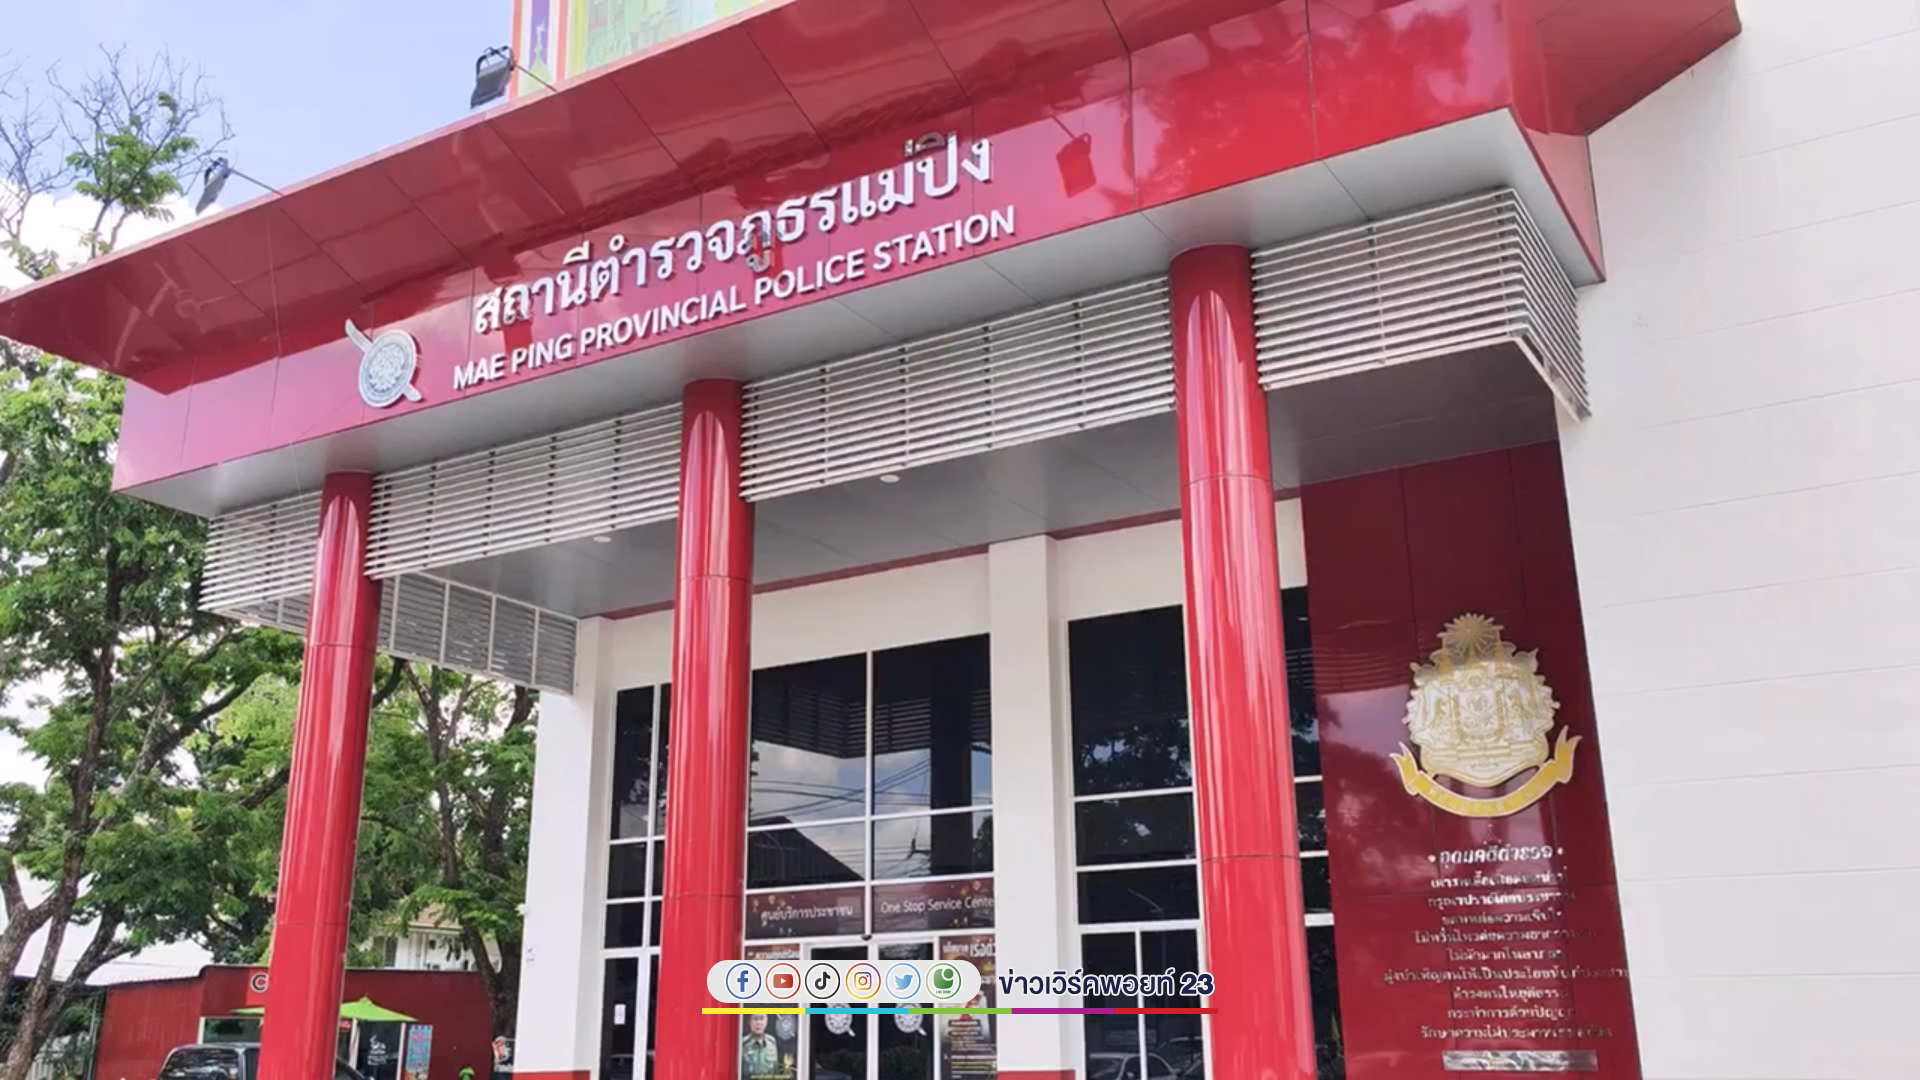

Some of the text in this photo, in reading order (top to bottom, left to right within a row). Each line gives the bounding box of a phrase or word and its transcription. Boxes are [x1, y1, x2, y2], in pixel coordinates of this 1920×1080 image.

[453, 205, 1016, 390] MAE PING PROVINCIAL POLICE STATION
[474, 131, 993, 334] สถานีตำรวจภูธรแม่ปิง
[880, 895, 996, 914] One Stop Service Cente
